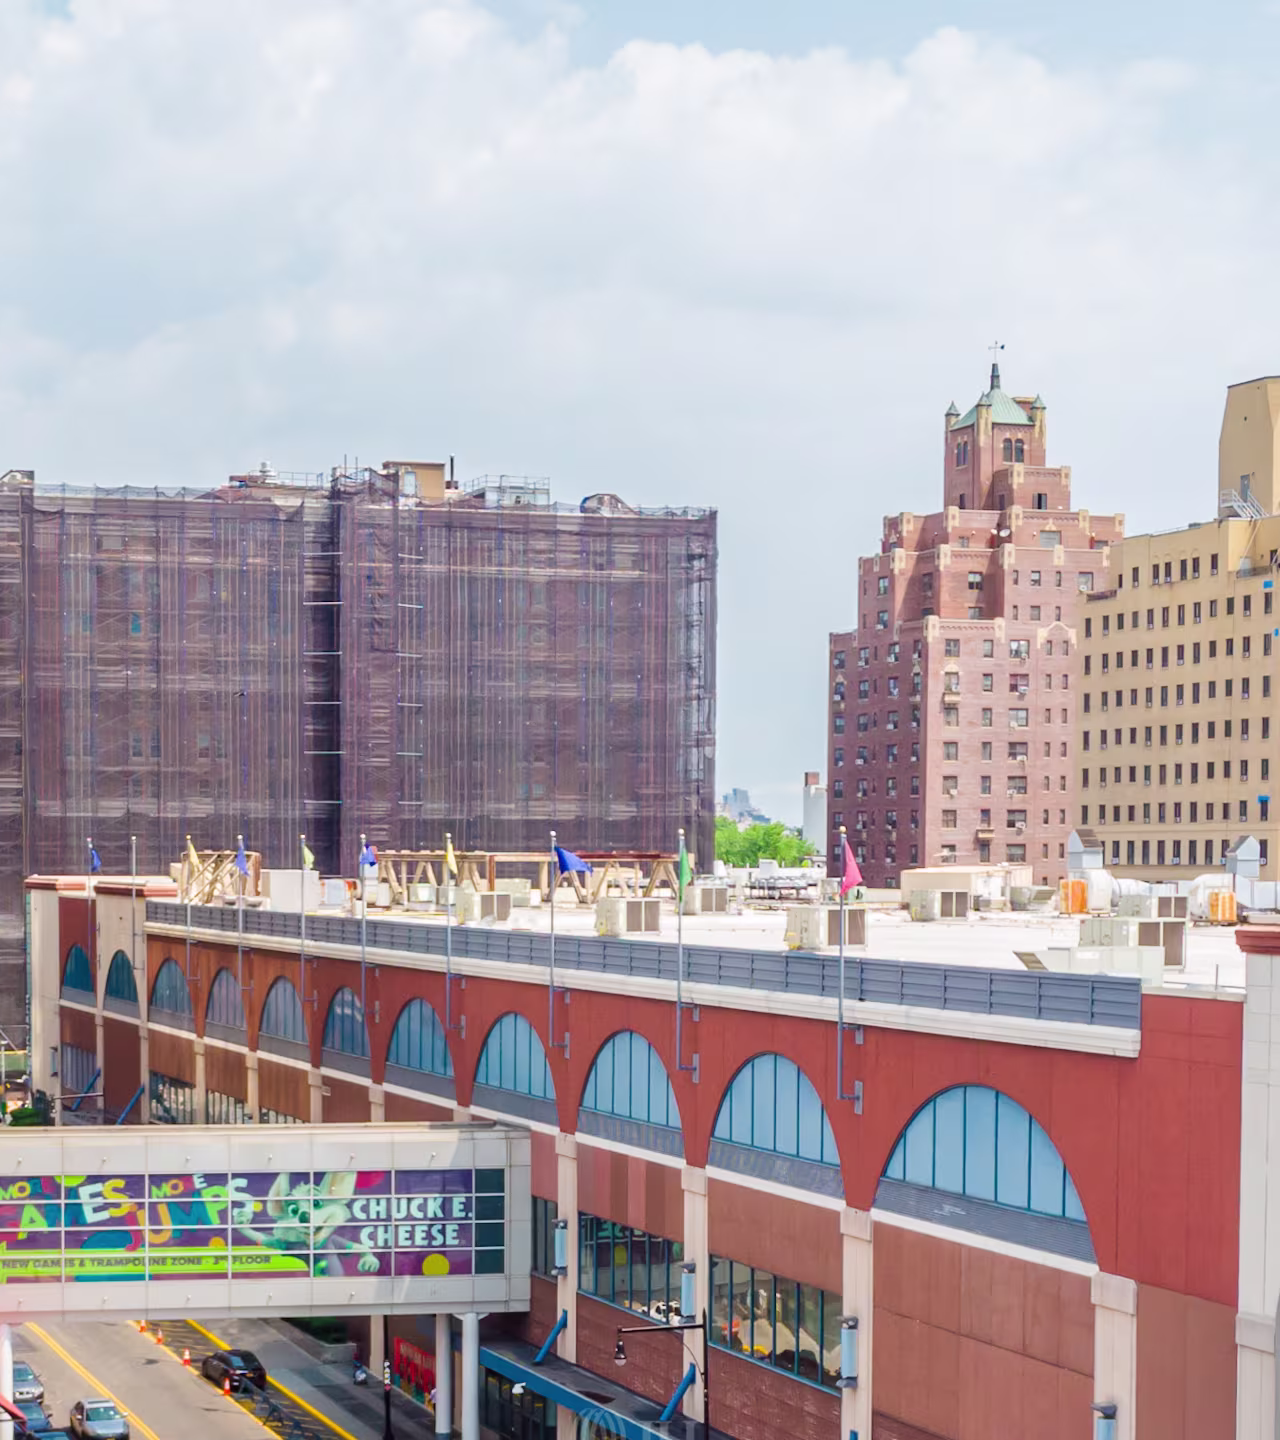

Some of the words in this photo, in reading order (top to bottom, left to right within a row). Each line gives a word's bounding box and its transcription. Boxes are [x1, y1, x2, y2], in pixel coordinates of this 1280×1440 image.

[151, 1173, 208, 1199] MORE
[124, 1178, 254, 1252] JUMPS
[352, 1197, 444, 1220] CHUCK
[452, 1196, 473, 1218] E.
[360, 1224, 460, 1247] CHEESE
[2, 1259, 28, 1269] NEW
[33, 1258, 75, 1268] GAMES
[90, 1256, 168, 1267] TRAMPOLINE
[171, 1255, 202, 1266] ZONE
[233, 1255, 271, 1265] FLOOR
